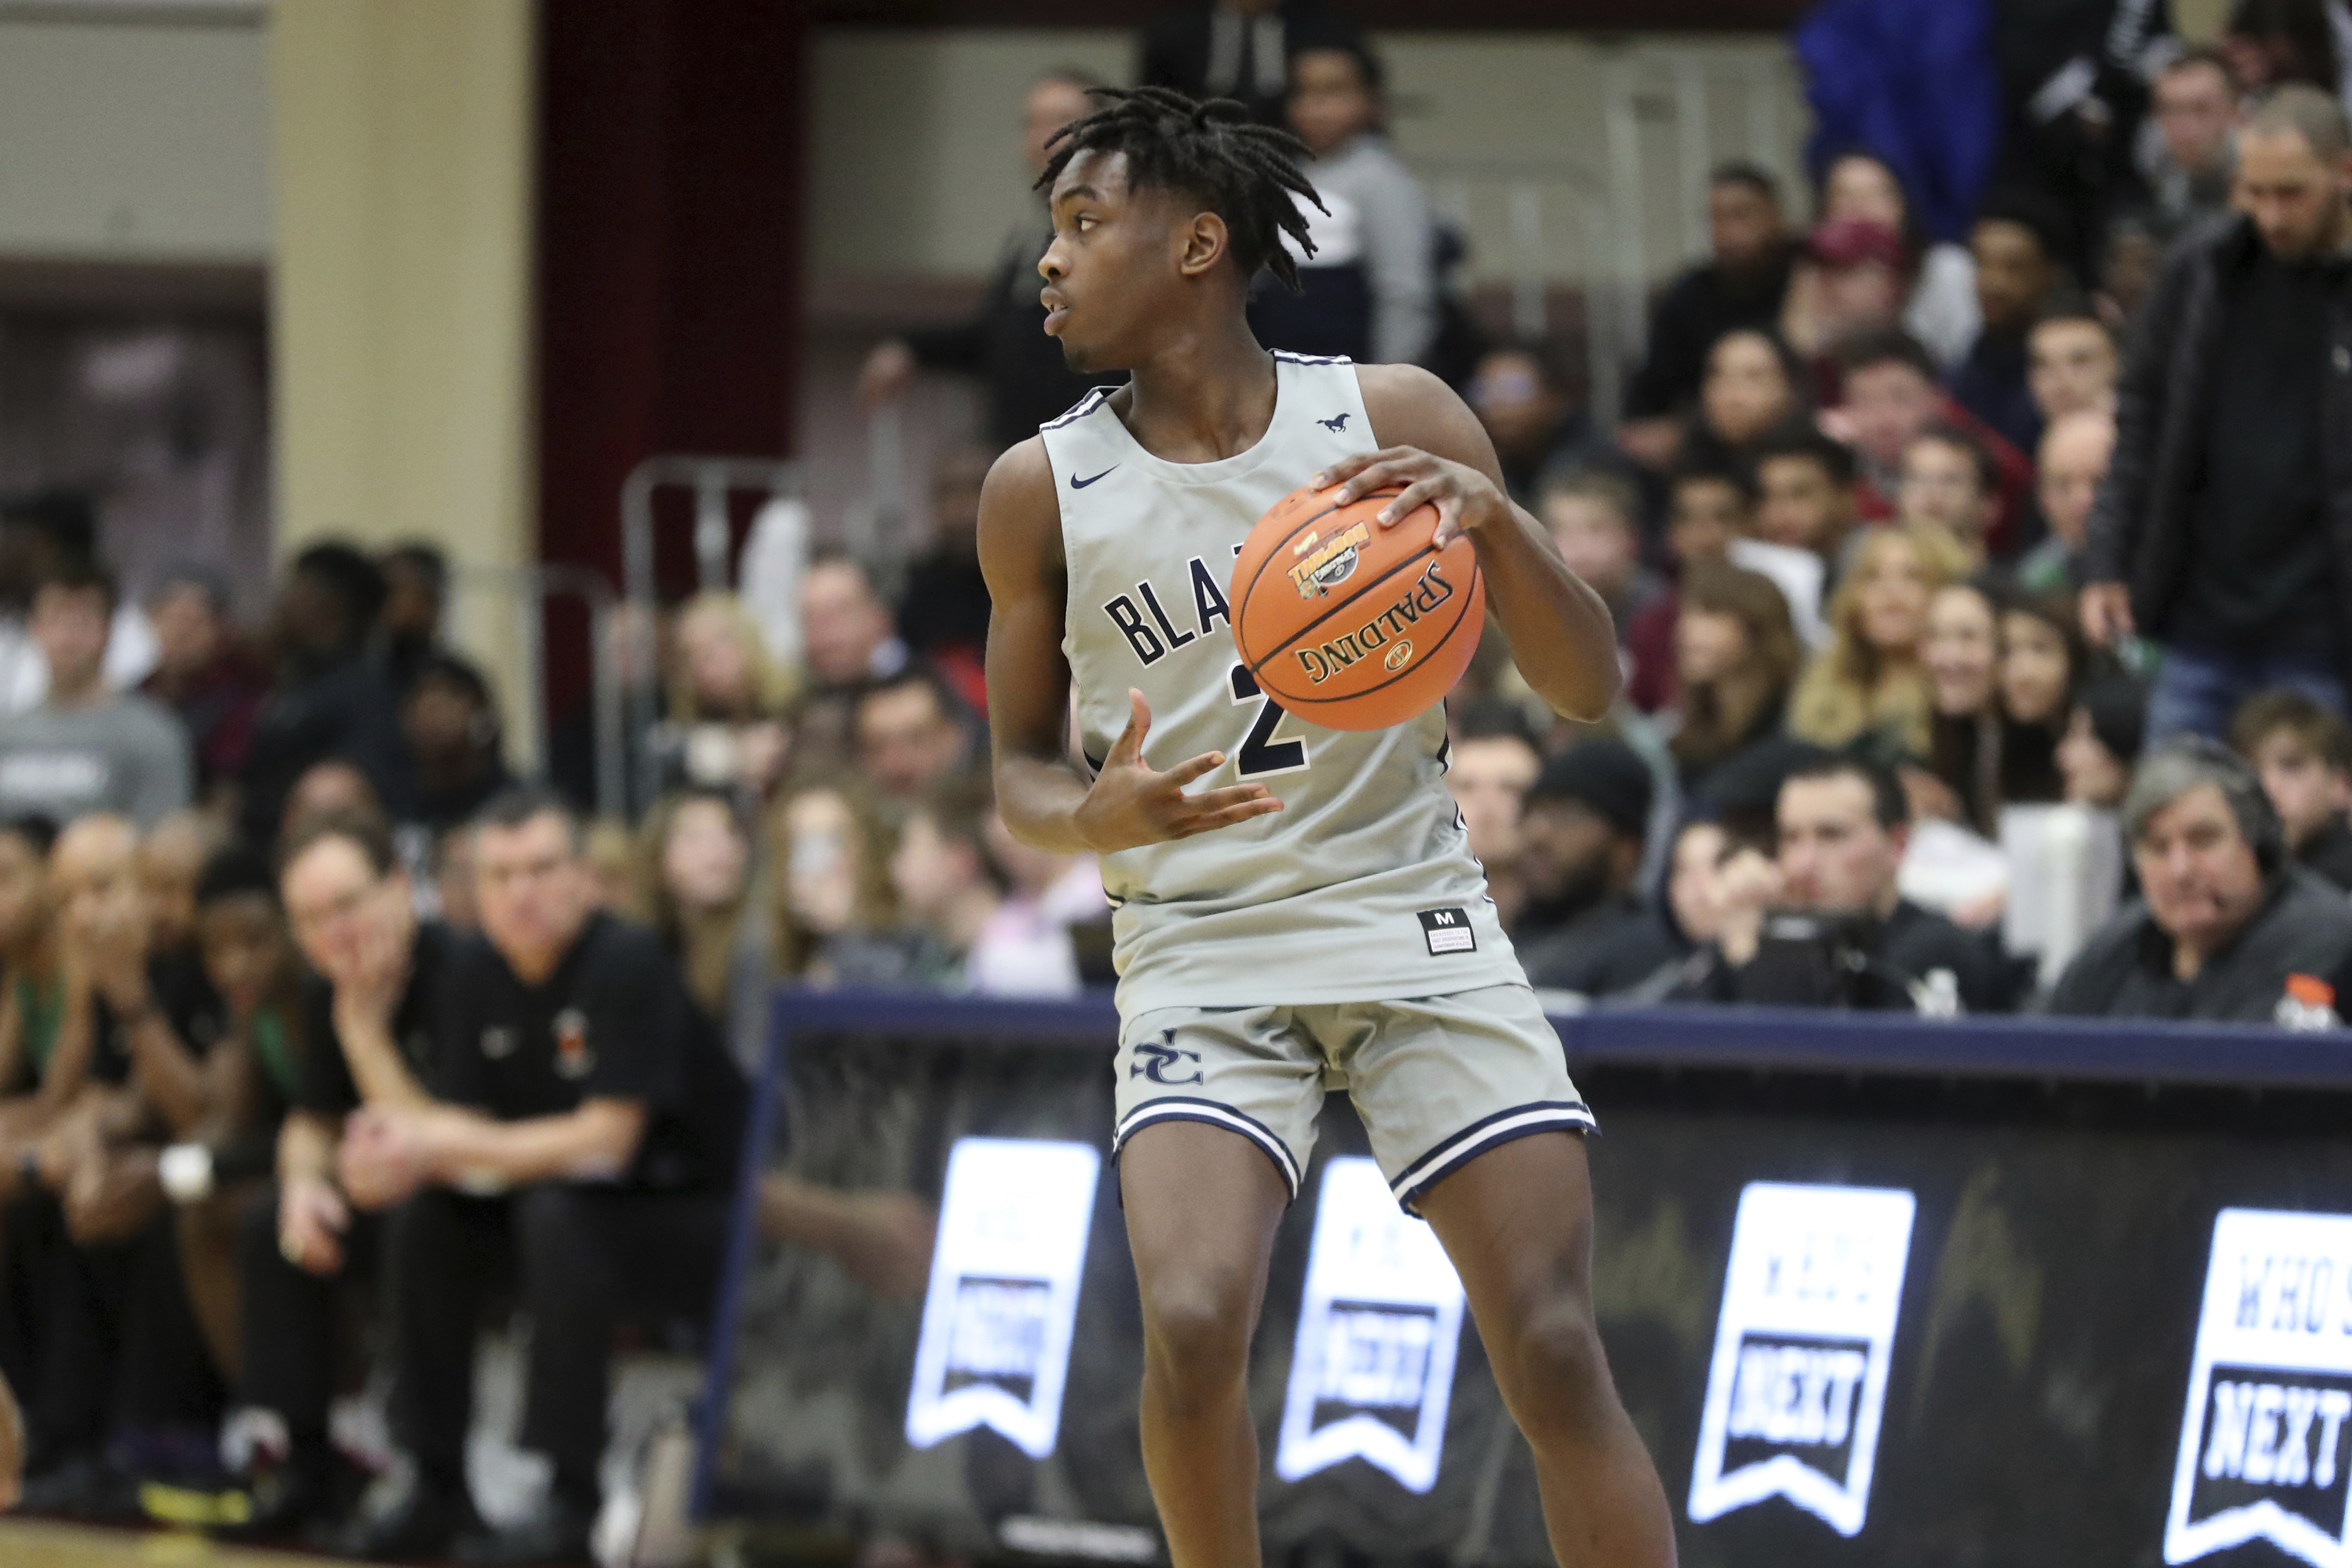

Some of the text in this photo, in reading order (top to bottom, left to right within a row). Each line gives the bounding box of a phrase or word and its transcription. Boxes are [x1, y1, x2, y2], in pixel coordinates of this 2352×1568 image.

[1101, 542, 1244, 669] BLA
[1296, 559, 1454, 685] SPALDING
[1227, 659, 1311, 781] 2
[1434, 912, 1455, 925] M
[1728, 1345, 1866, 1446] NEXT
[2203, 1381, 2352, 1490] NEXT
